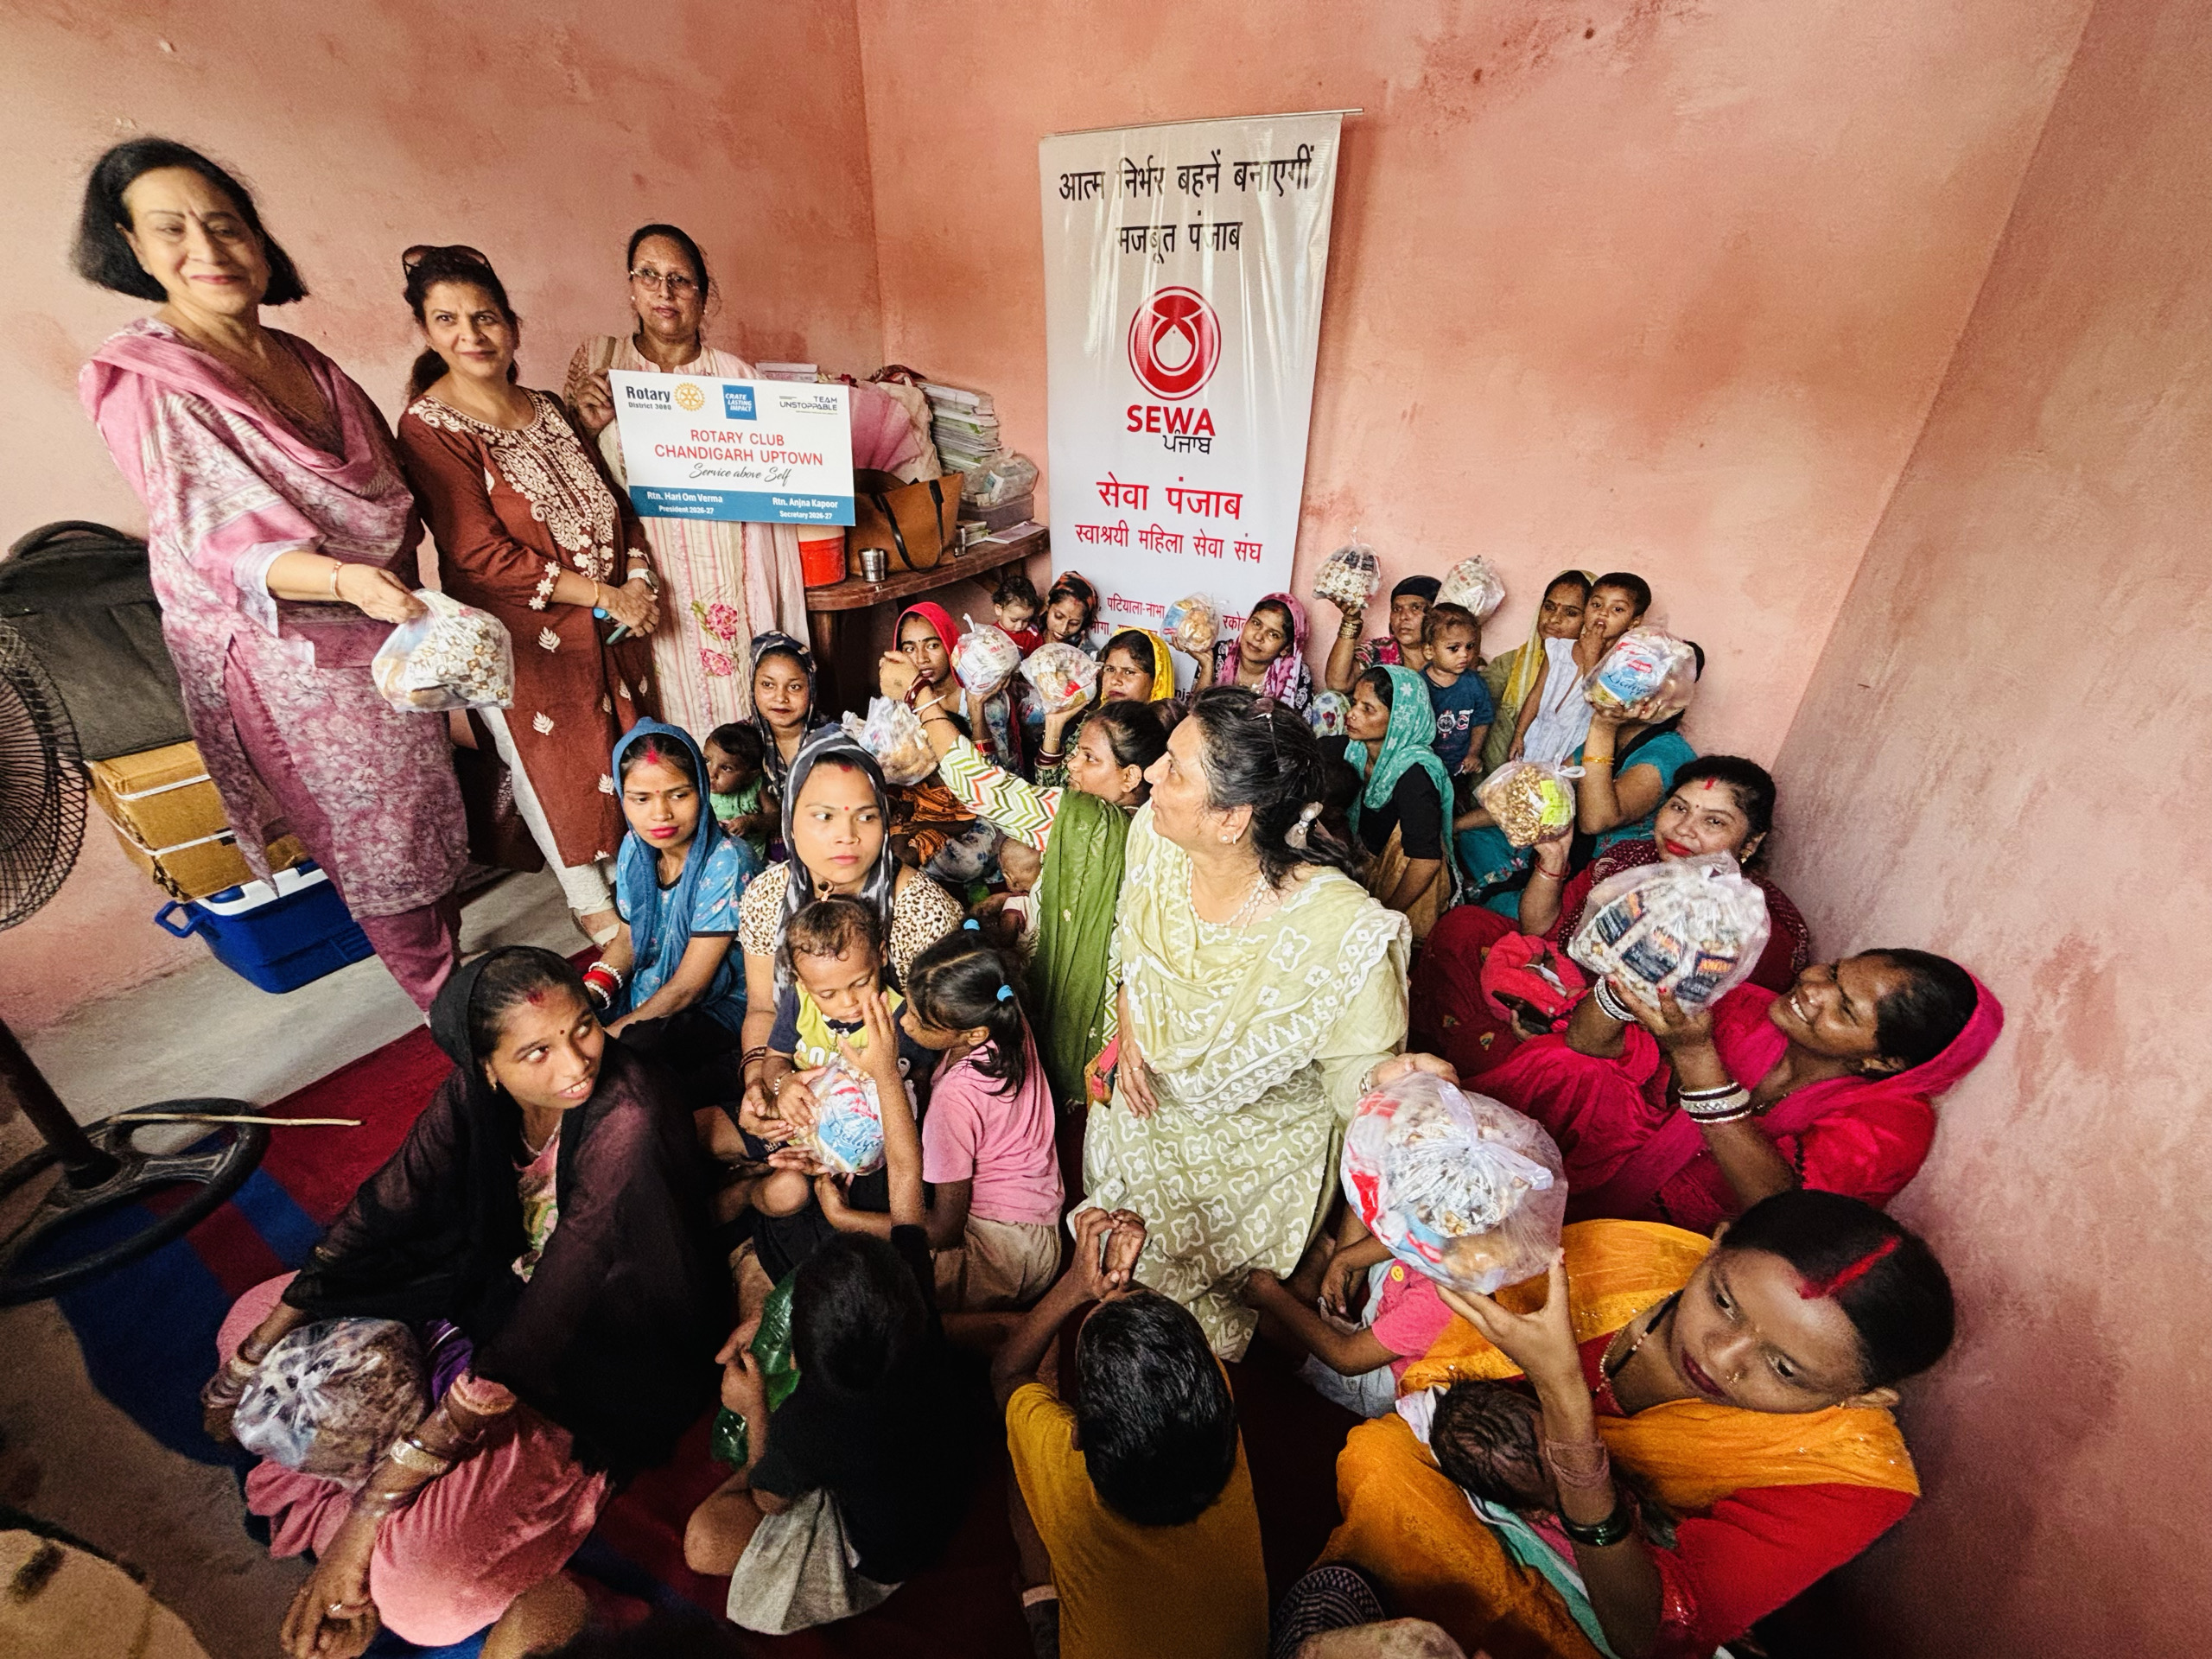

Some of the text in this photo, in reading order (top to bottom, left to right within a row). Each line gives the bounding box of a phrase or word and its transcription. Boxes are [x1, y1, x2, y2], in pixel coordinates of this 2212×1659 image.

[1059, 143, 1314, 201] आत्म निर्भर बहनें बनाएगीं
[1116, 210, 1243, 264] मजबूत पंजाब
[626, 385, 671, 403] Rotary
[779, 401, 837, 410] UNSTOPPABLE
[1127, 404, 1216, 436] SEWA
[690, 429, 785, 446] ROTARY CLUB
[1162, 429, 1212, 454] ਪੰਜਾਬ
[654, 444, 823, 466] CHANDIGARH UPTOWN
[689, 462, 792, 486] Service above Self
[646, 491, 723, 503] Rtn. Hari Om Verma
[772, 497, 788, 506] Rtn.
[810, 499, 838, 509] Kapoor
[1096, 471, 1243, 520] सेवा पंजाब
[658, 505, 689, 513] President
[779, 510, 808, 520] Secretary
[1075, 519, 1262, 563] स्वाश्रयी महिला सेवा संघ
